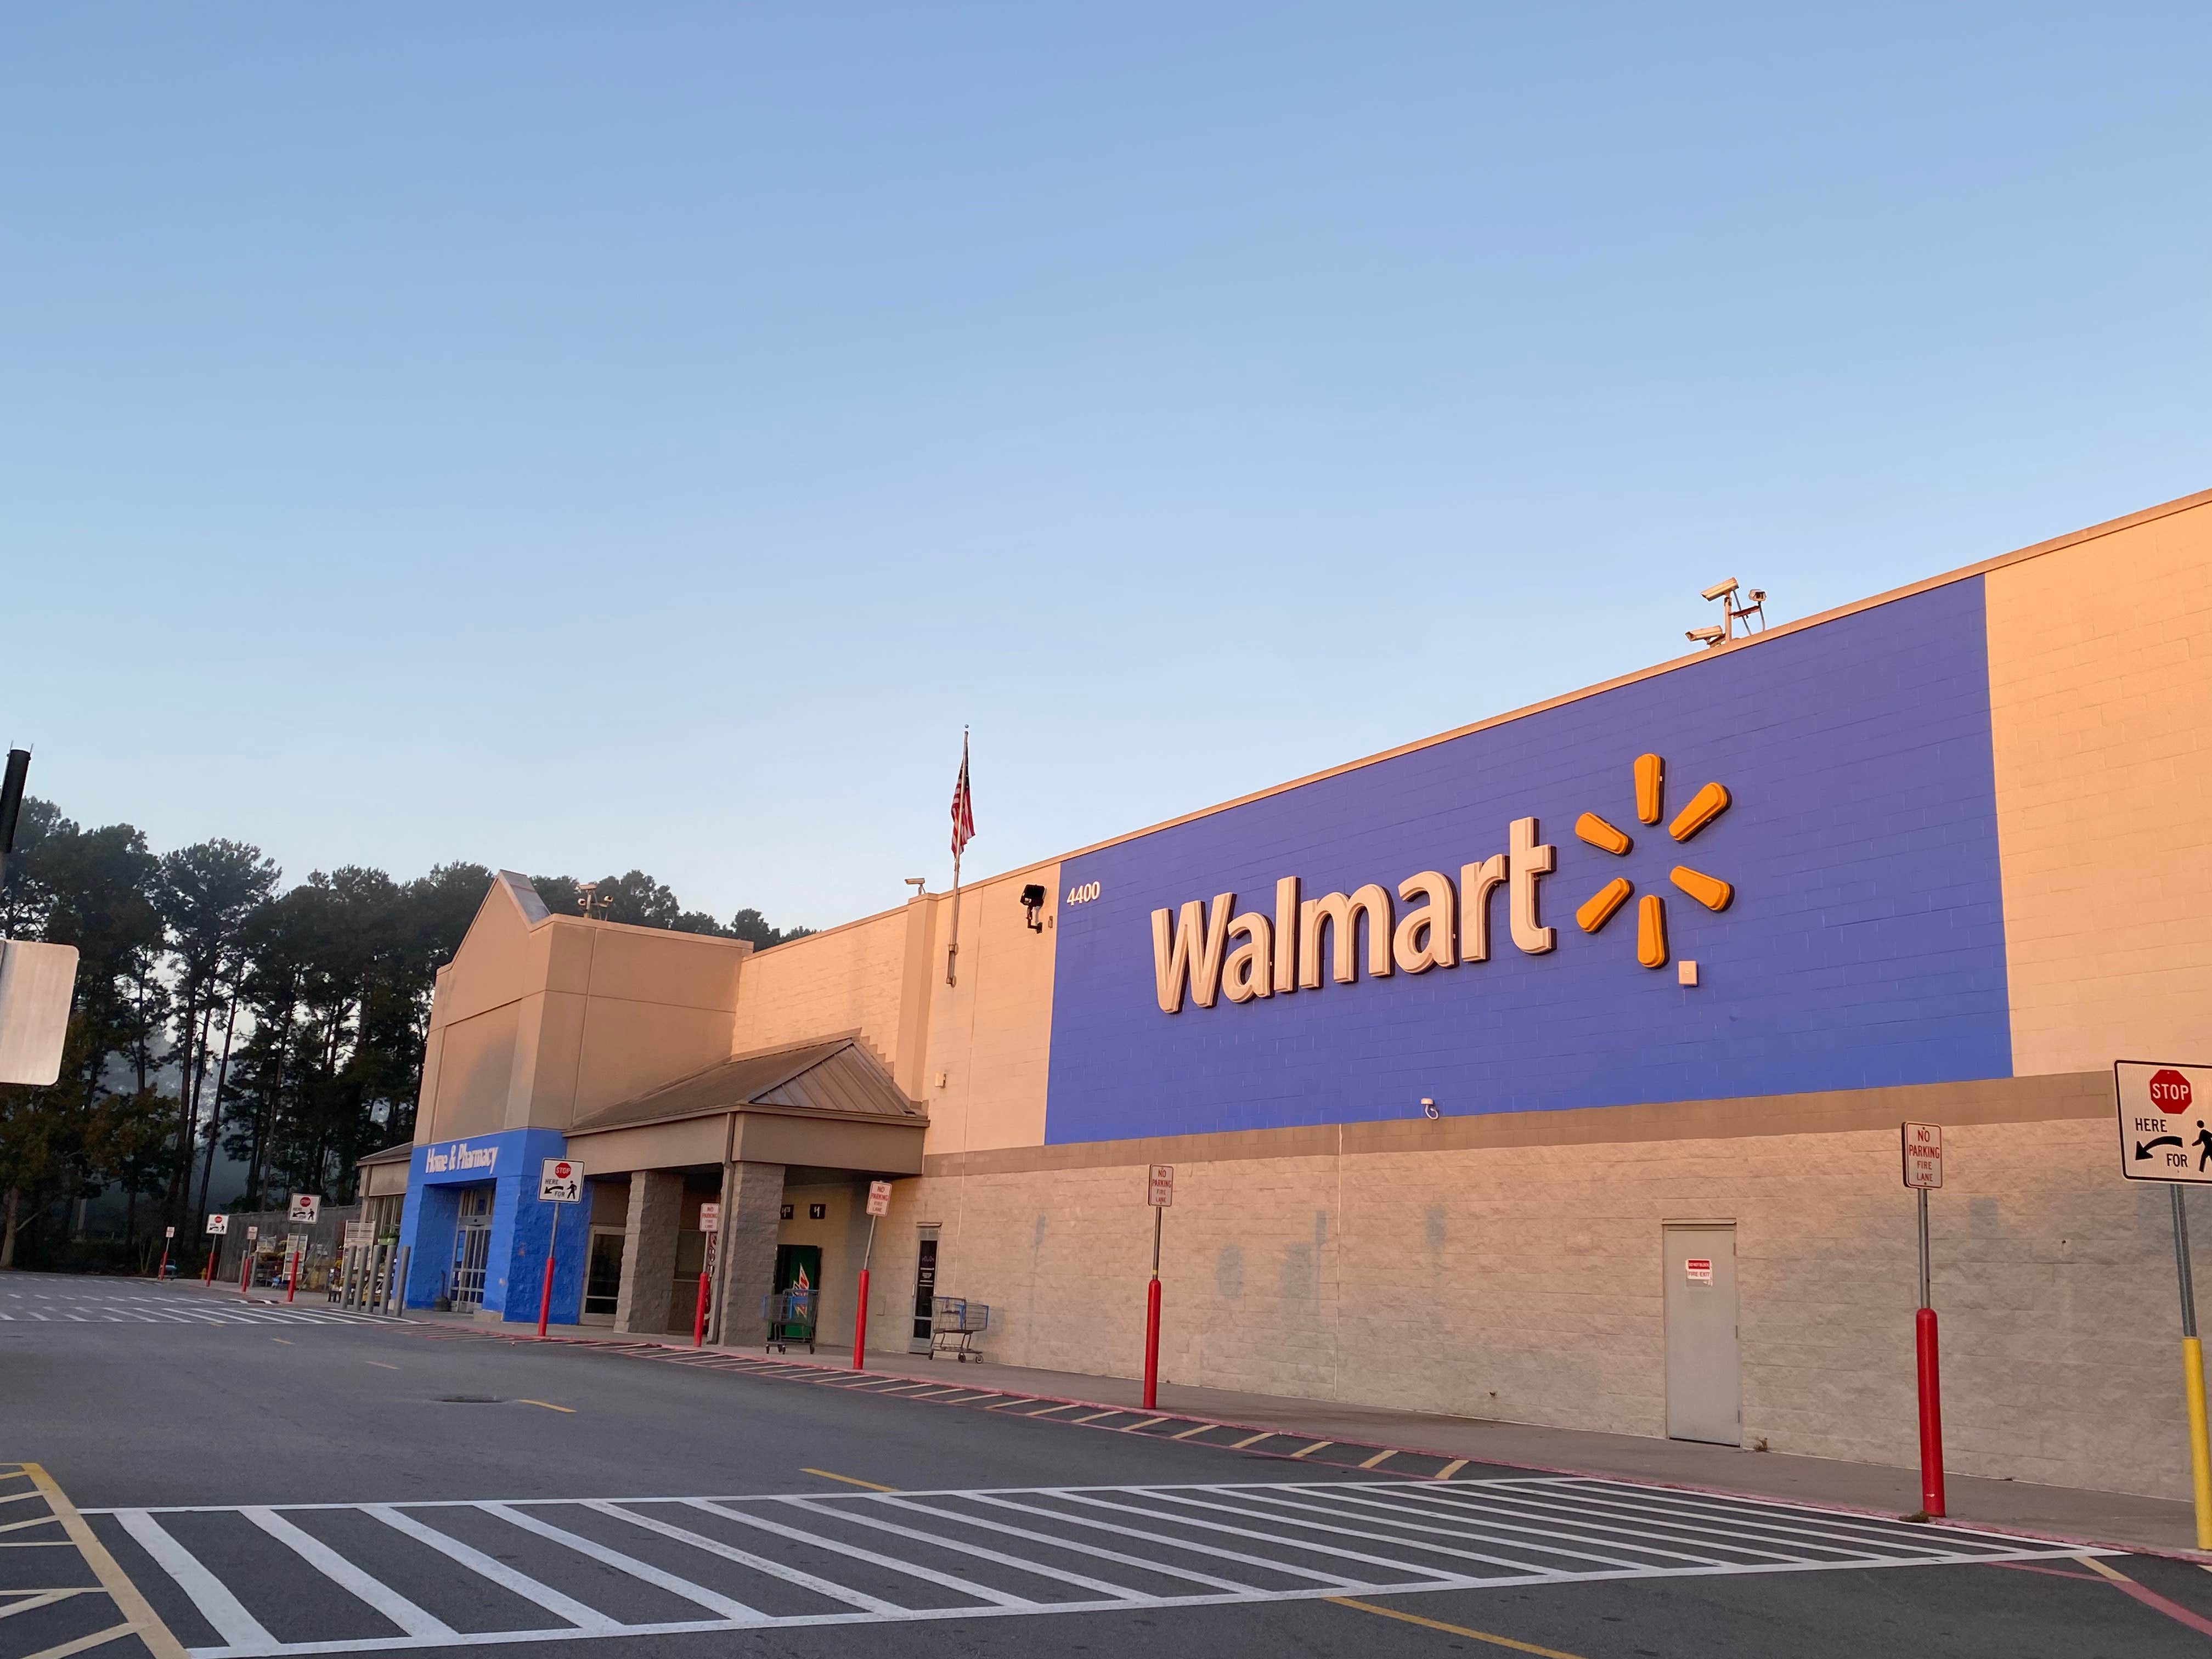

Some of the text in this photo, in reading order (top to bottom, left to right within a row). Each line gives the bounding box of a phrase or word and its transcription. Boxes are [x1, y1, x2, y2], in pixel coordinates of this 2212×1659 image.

[1066, 881, 1101, 906] 4400
[1151, 816, 1557, 1014] Walmart
[2152, 1083, 2189, 1100] STOP
[2135, 1118, 2168, 1132] HERE
[1918, 1130, 1930, 1142] NO
[1909, 1144, 1940, 1159] PARKING
[426, 1143, 499, 1175] Home & Pharmacy
[1917, 1161, 1932, 1170] FIRE
[2166, 1153, 2188, 1167] FOR
[1158, 1169, 1166, 1178] NO
[1916, 1173, 1933, 1182] LANE
[1152, 1179, 1171, 1188] PARKING
[871, 1193, 889, 1201] PARKING
